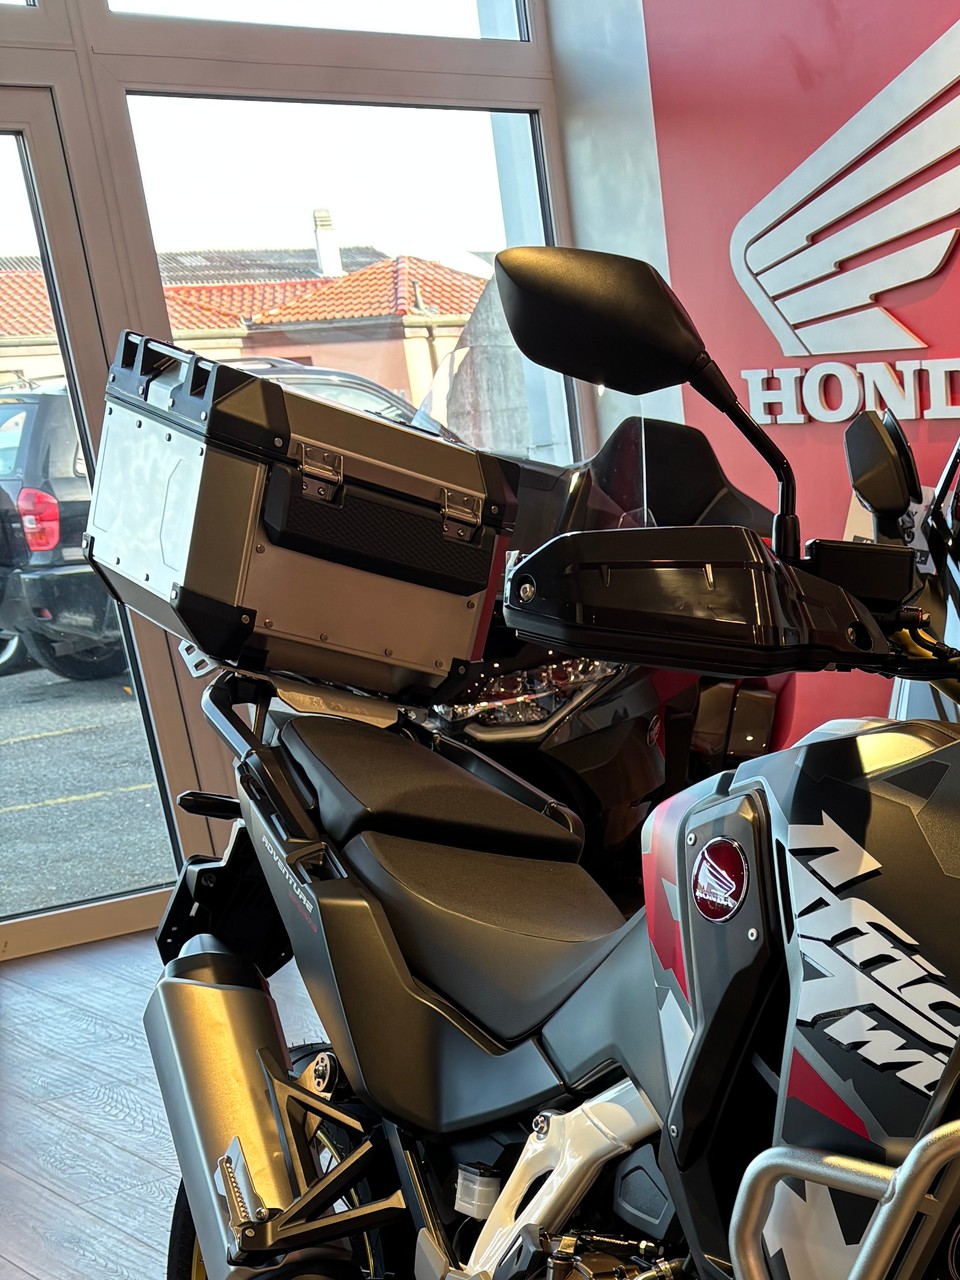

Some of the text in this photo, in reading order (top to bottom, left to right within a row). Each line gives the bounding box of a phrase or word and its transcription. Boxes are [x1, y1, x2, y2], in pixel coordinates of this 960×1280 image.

[261, 834, 314, 914] ADVENTURE
[696, 888, 737, 908] HONDA
[797, 936, 958, 1097] Twi
